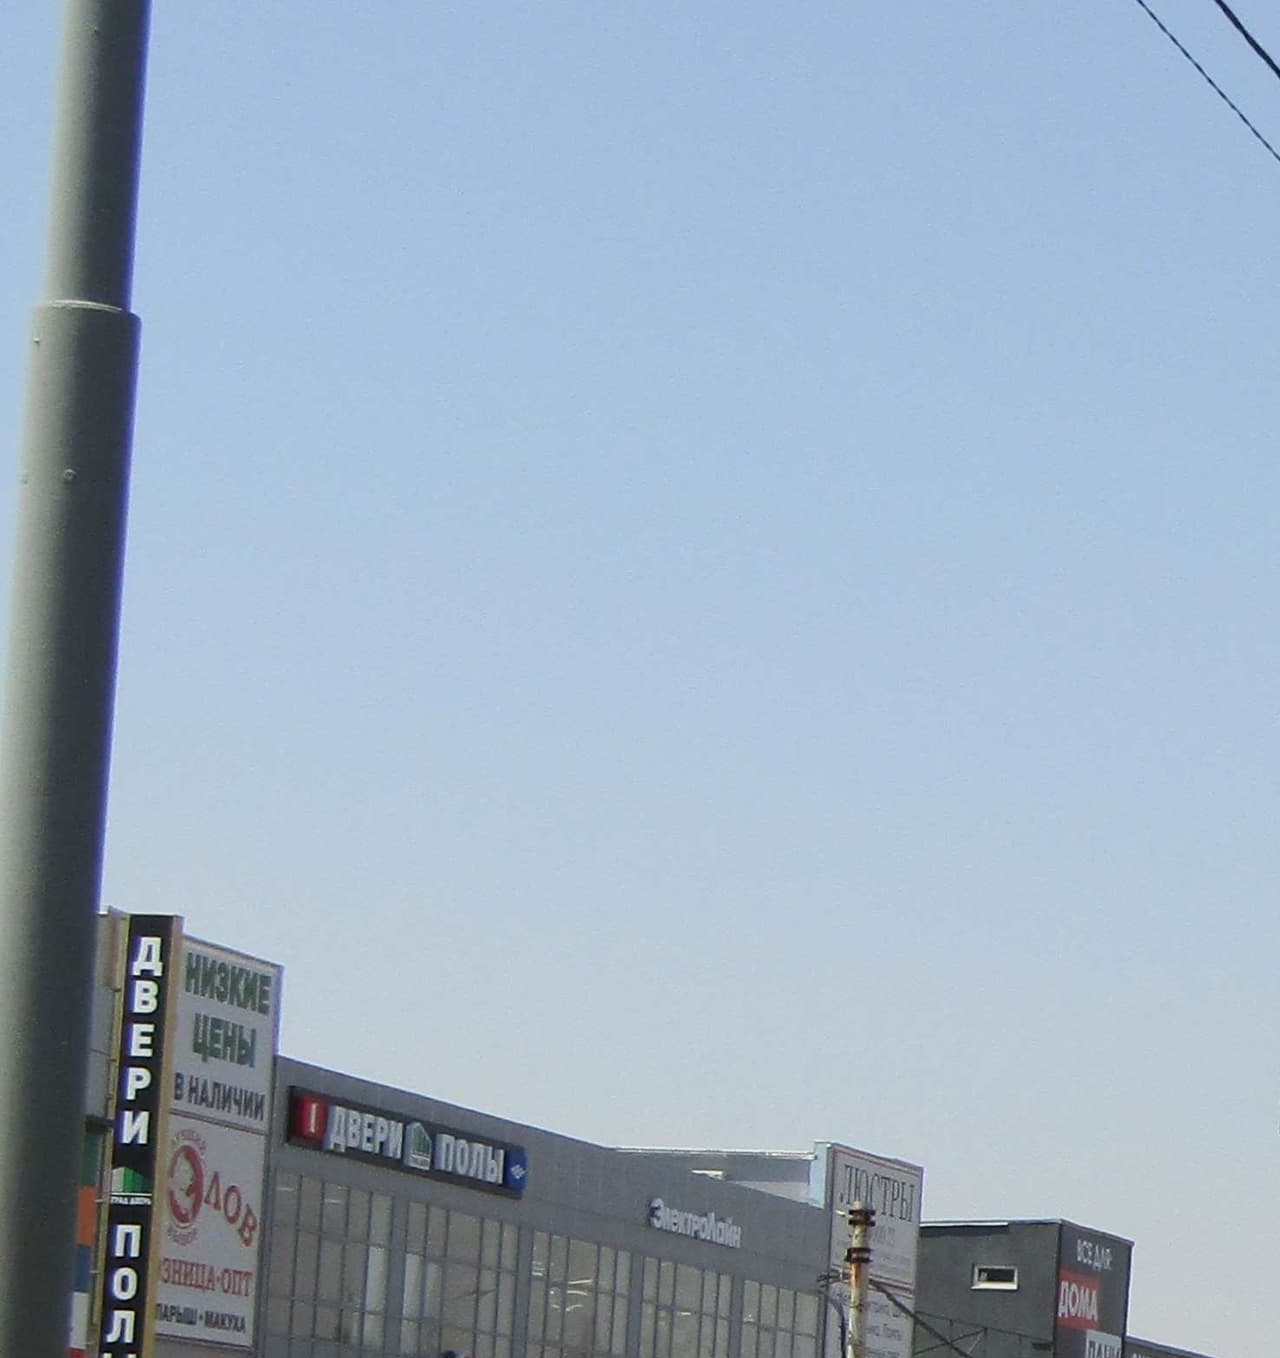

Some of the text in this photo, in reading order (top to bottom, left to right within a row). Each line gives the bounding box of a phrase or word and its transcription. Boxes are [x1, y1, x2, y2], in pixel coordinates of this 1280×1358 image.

[185, 952, 272, 1015] НИЗКИЕ
[122, 936, 163, 1144] ДВЕРИ
[192, 1012, 257, 1067] ЦЕНЫ
[188, 1074, 266, 1121] НАЛИЧИИ
[326, 1105, 404, 1160] ДВЕРИ
[435, 1133, 505, 1185] ПОЛЫ
[839, 1163, 916, 1223] ЛЮСТРЫ
[1058, 1281, 1098, 1322] ДОМА
